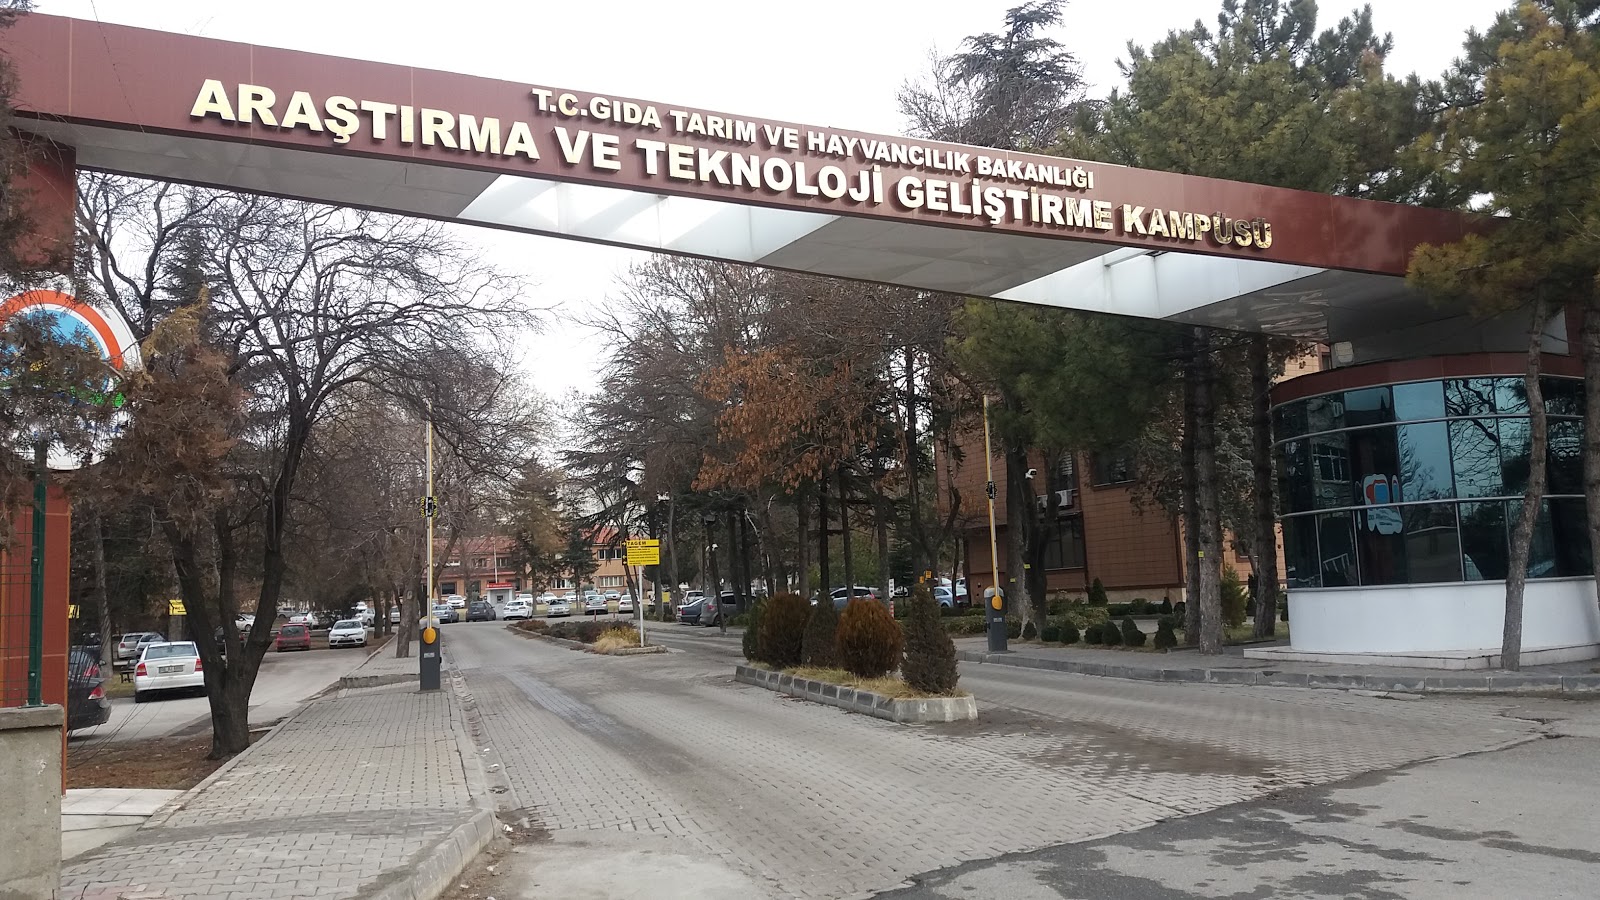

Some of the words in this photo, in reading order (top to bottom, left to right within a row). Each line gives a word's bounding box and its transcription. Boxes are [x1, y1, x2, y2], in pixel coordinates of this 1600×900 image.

[190, 78, 541, 161] ARAŞTIRMA
[553, 126, 622, 171] VE
[635, 138, 884, 206] TEKNOLOJİ
[896, 175, 1115, 230] GELİŞTİRME
[1122, 203, 1274, 250] KAMPÜSÜ
[669, 109, 757, 144] TARIM
[762, 124, 800, 150] VE
[806, 130, 971, 173] HAYVANCILIK
[976, 155, 1094, 189] BAKANLIĞI
